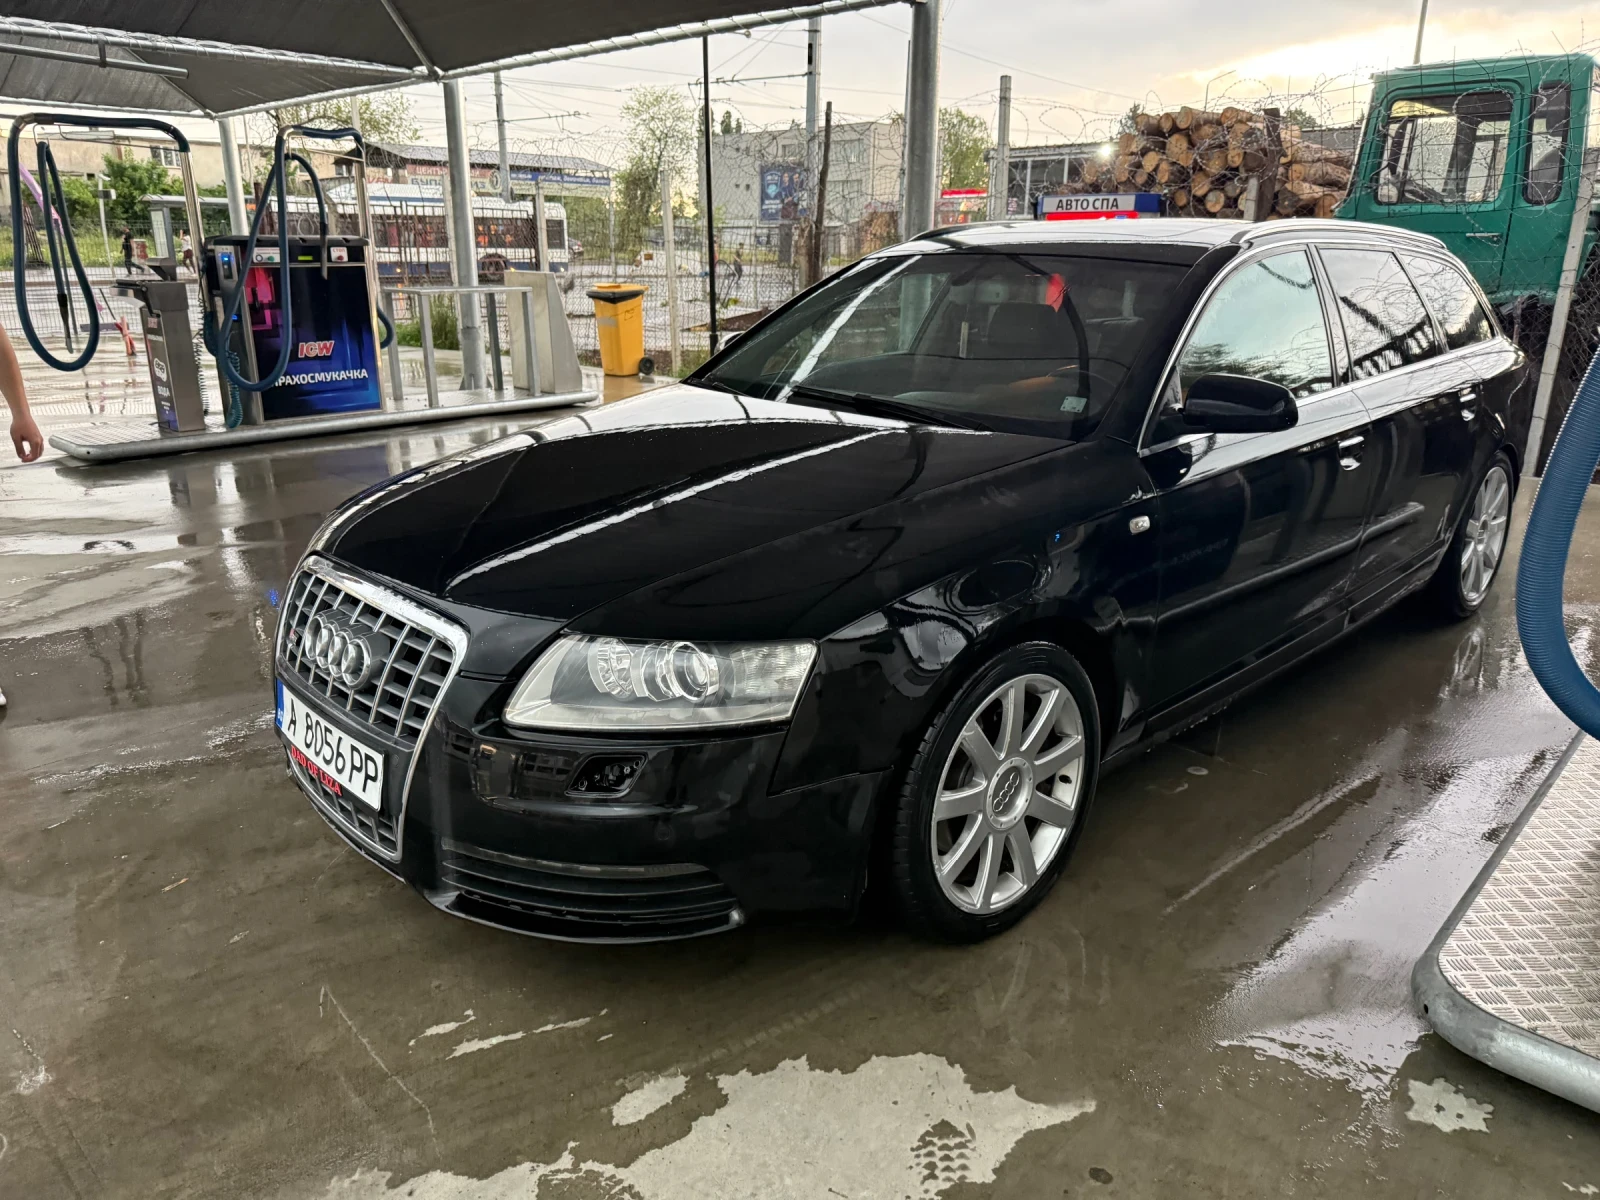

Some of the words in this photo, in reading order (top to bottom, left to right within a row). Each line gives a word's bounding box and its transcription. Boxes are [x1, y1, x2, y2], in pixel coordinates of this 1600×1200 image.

[1056, 198, 1089, 211] АВТО
[1092, 198, 1119, 210] СПА
[298, 340, 335, 358] ICW
[287, 698, 297, 737] A
[304, 711, 346, 775] 8056
[348, 743, 379, 794] PP
[291, 745, 307, 767] DAD
[307, 760, 318, 779] OF
[319, 769, 342, 796] LIZA
